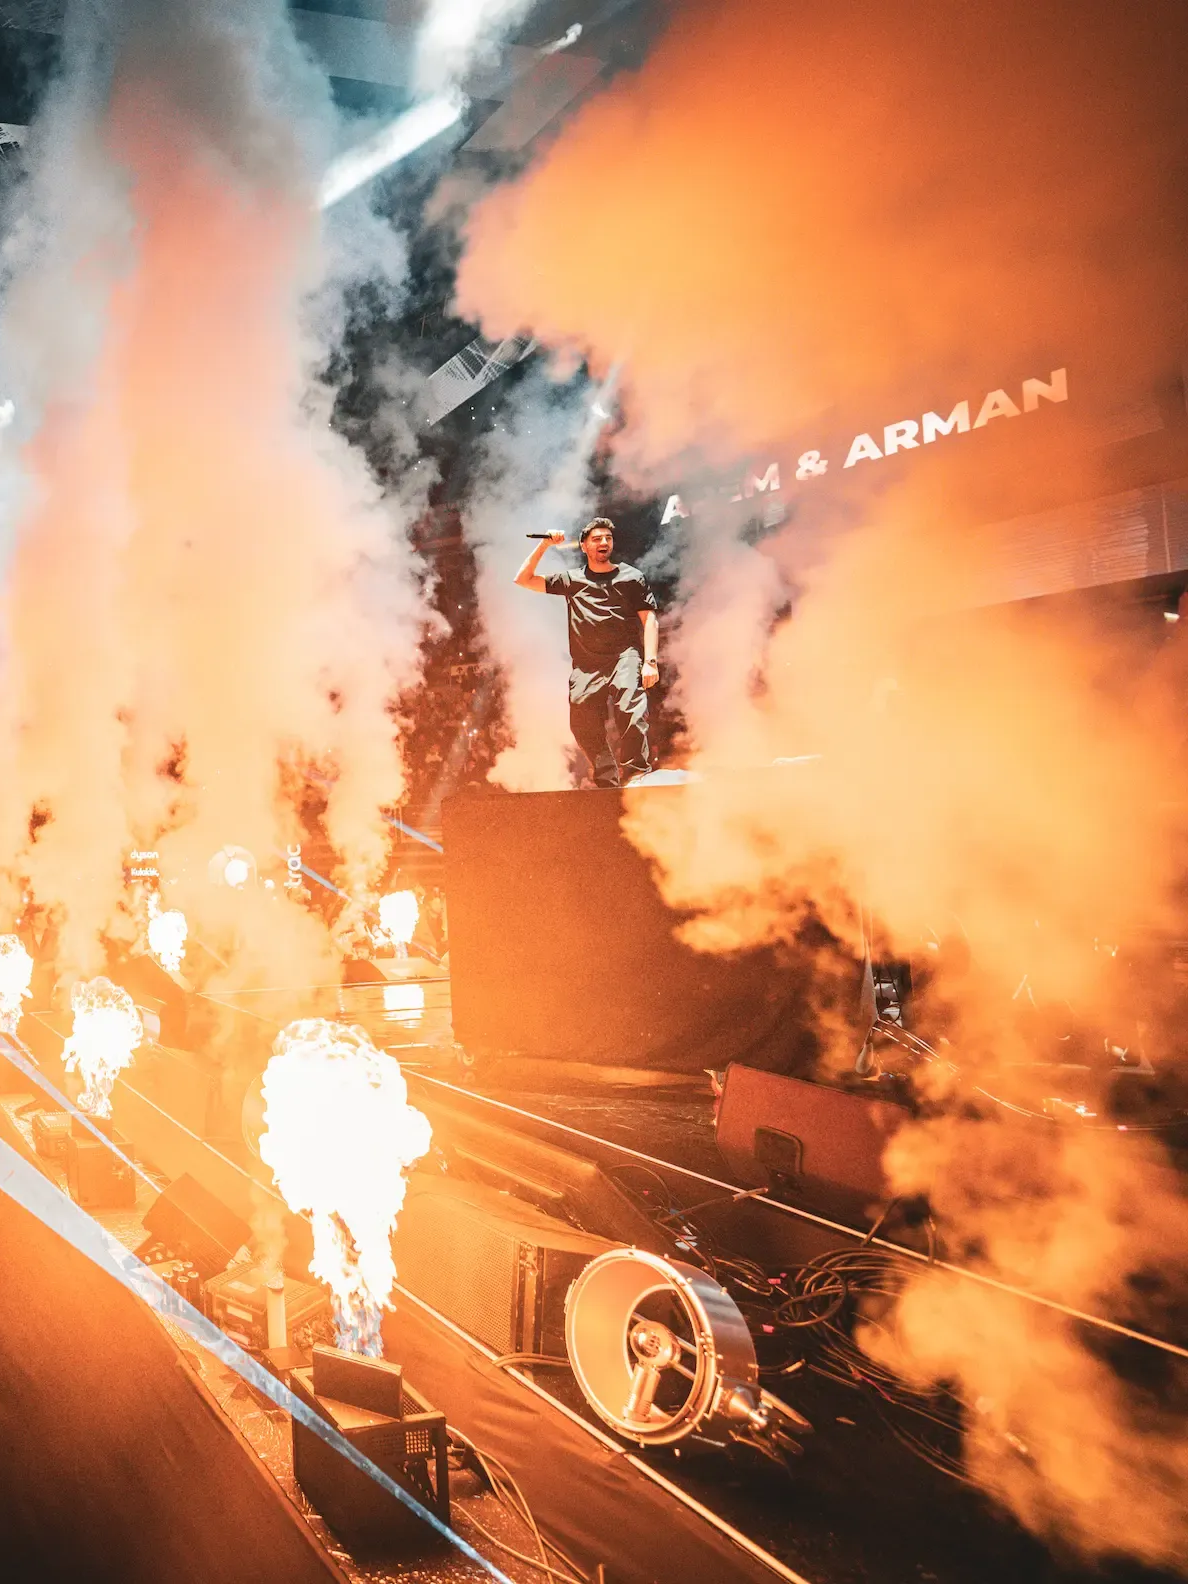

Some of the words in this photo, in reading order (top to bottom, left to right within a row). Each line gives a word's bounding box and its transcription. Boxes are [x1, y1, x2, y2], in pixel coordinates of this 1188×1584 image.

[795, 449, 828, 481] &
[843, 367, 1068, 468] ARMAN
[130, 848, 159, 862] dyson
